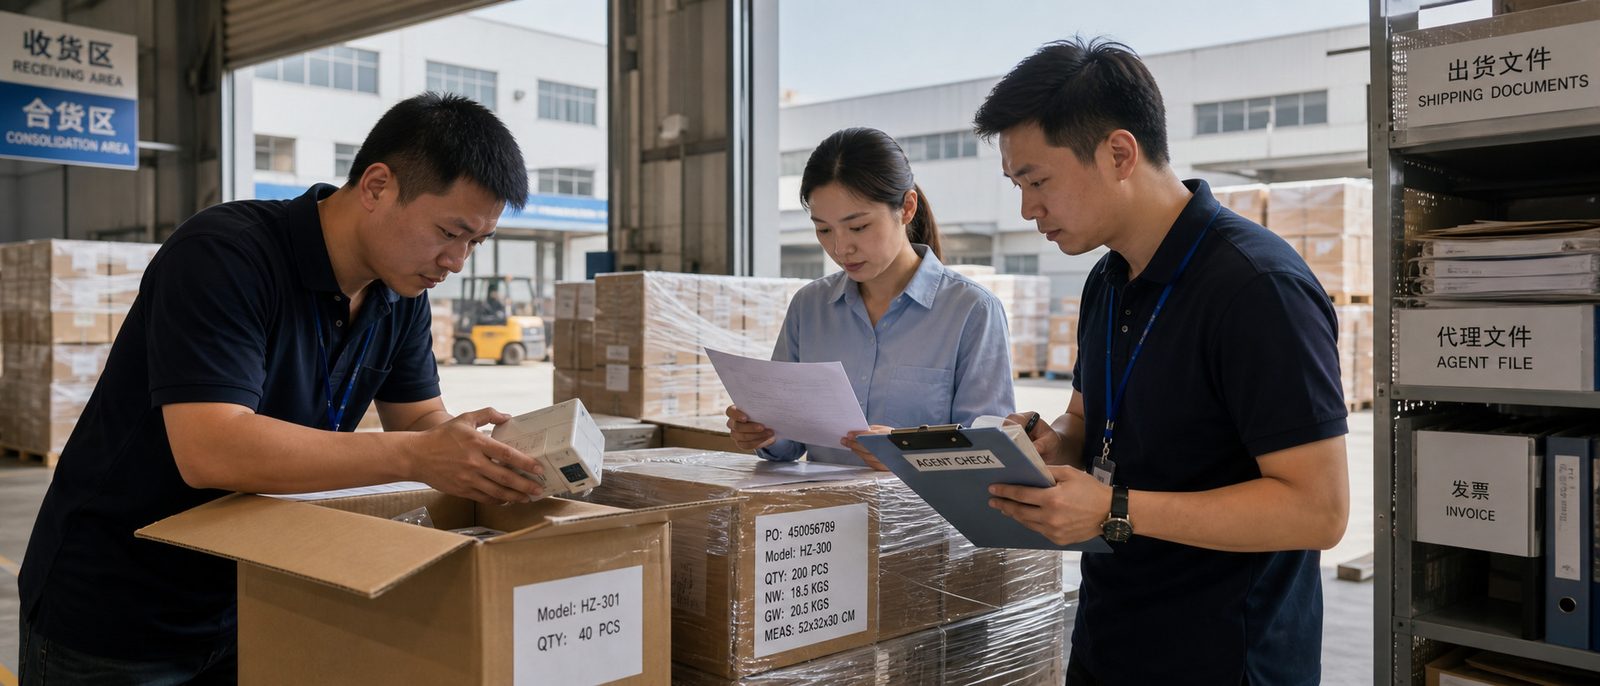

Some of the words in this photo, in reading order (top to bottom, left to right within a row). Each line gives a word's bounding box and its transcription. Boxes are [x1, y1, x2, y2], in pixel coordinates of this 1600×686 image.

[23, 29, 113, 68] 收货区
[12, 60, 85, 82] RECEIVING
[89, 73, 123, 87] AREA
[1448, 46, 1552, 82] 出货文件
[1418, 88, 1483, 108] SHIPPING
[1491, 74, 1589, 99] DOCUMENTS
[22, 97, 116, 136] 合货区
[6, 131, 98, 151] CONSOLIDATION
[101, 141, 130, 155] AREA
[1436, 325, 1532, 348] 代理文件
[1436, 356, 1489, 369] AGENT
[1498, 356, 1533, 370] FILE
[916, 457, 952, 468] AGENT
[954, 455, 995, 466] CHECK
[1451, 480, 1490, 500] 发票
[1446, 505, 1496, 522] INVOICE
[765, 528, 782, 542] PO:
[788, 521, 836, 538] 450056789
[765, 547, 796, 563] Model:
[800, 541, 832, 557] HZ-300
[764, 570, 787, 585] QTY:
[791, 567, 808, 581] 200
[811, 562, 829, 576] PCS
[765, 590, 784, 604] NW:
[791, 585, 809, 599] 18.5
[811, 580, 829, 594] KGS
[537, 602, 576, 622] Model:
[581, 592, 619, 613] HZ-301
[764, 608, 784, 623] GW:
[790, 603, 809, 617] 20.5
[811, 597, 829, 612] KGS
[537, 632, 567, 652] QTY:
[579, 626, 592, 641] 40
[599, 619, 621, 637] PCS
[764, 624, 795, 642] MEAS:
[798, 614, 839, 634] 52x32x30
[841, 609, 855, 623] CM
